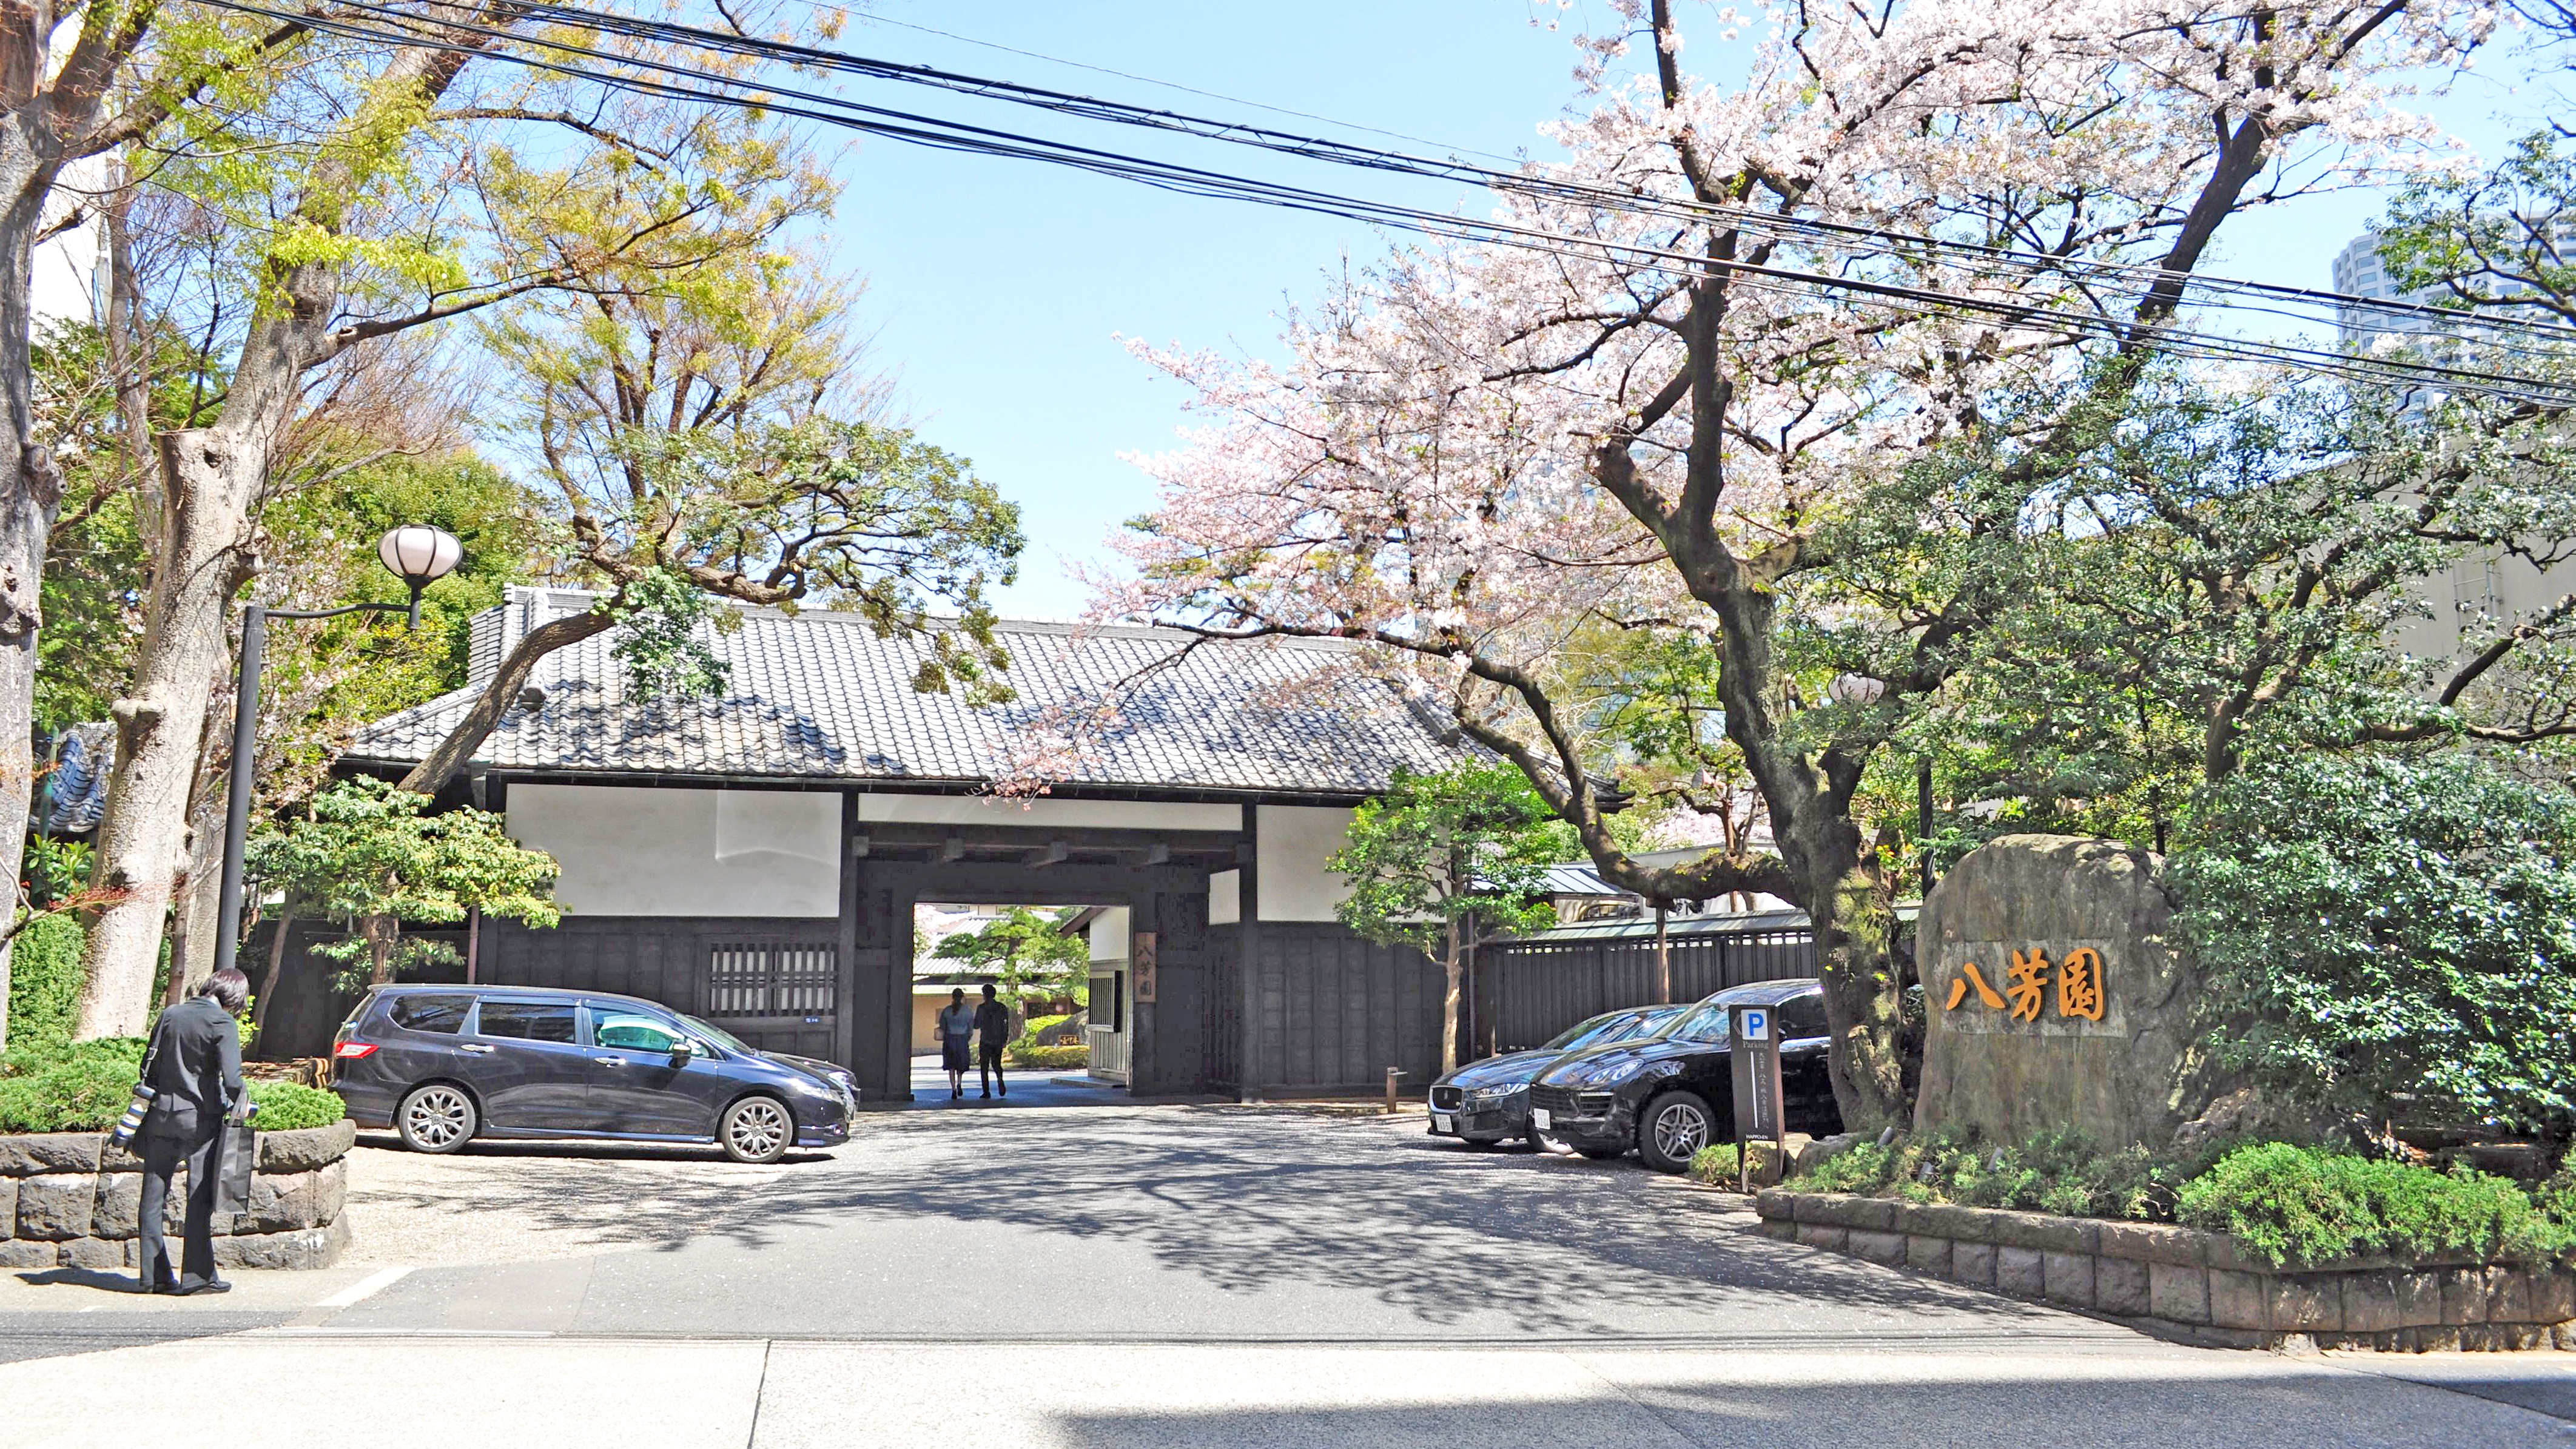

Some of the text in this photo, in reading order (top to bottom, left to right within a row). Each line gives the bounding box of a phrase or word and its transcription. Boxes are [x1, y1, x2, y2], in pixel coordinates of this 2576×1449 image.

[1137, 946, 1154, 996] 八芳園
[1945, 946, 2105, 1023] 八芳園
[1748, 1013, 1764, 1037] P
[1743, 1040, 1769, 1049] Parking
